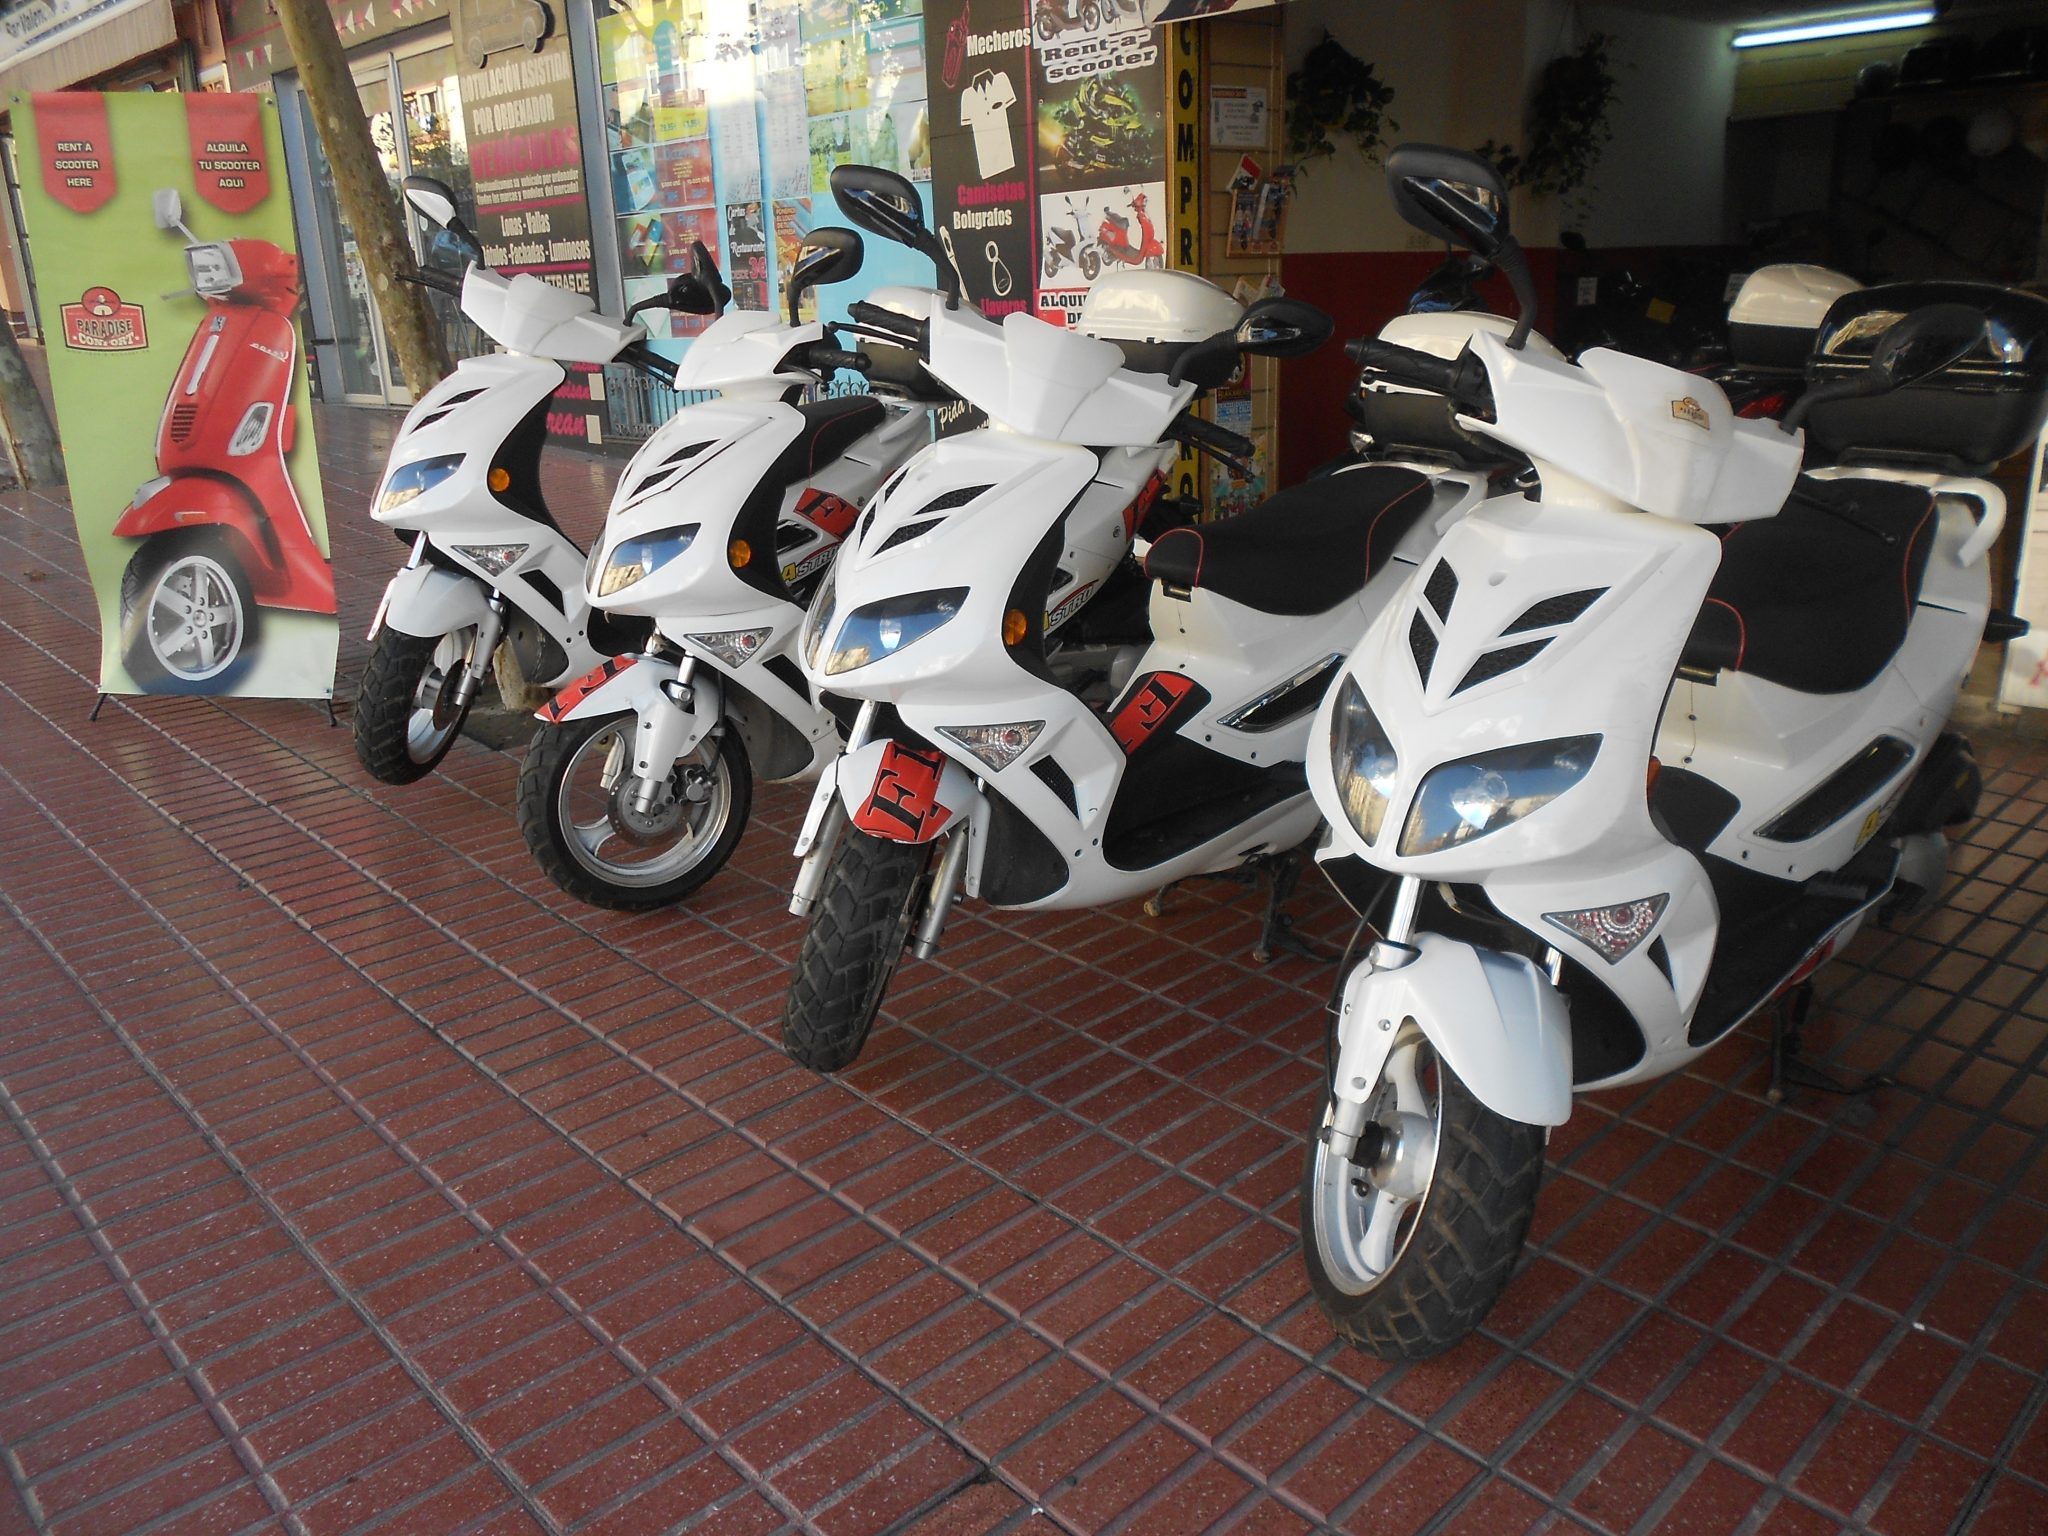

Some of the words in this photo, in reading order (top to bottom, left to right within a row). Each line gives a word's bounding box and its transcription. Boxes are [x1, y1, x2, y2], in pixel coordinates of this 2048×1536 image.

[966, 27, 1032, 57] Mecheros
[521, 51, 571, 89] ASISTIDA
[1049, 51, 1155, 79] scooter
[472, 105, 494, 136] POR
[494, 93, 555, 131] ORDENADOR
[57, 142, 82, 152] RENT
[85, 142, 93, 152] A
[206, 143, 248, 153] ALQUILA
[1177, 20, 1194, 265] COMPR
[55, 160, 99, 170] SCOOTER
[199, 161, 212, 170] TU
[214, 161, 260, 170] SCOOTER
[67, 178, 93, 187] HERE
[219, 178, 244, 188] AQUI
[957, 181, 1026, 206] Camisetas
[501, 215, 523, 237] Lonas
[526, 211, 550, 234] Vallas
[482, 244, 508, 266] ótulos
[549, 238, 591, 262] Luminosos
[576, 272, 591, 293] DE
[77, 319, 133, 337] PARADISE
[937, 399, 966, 431] Pida
